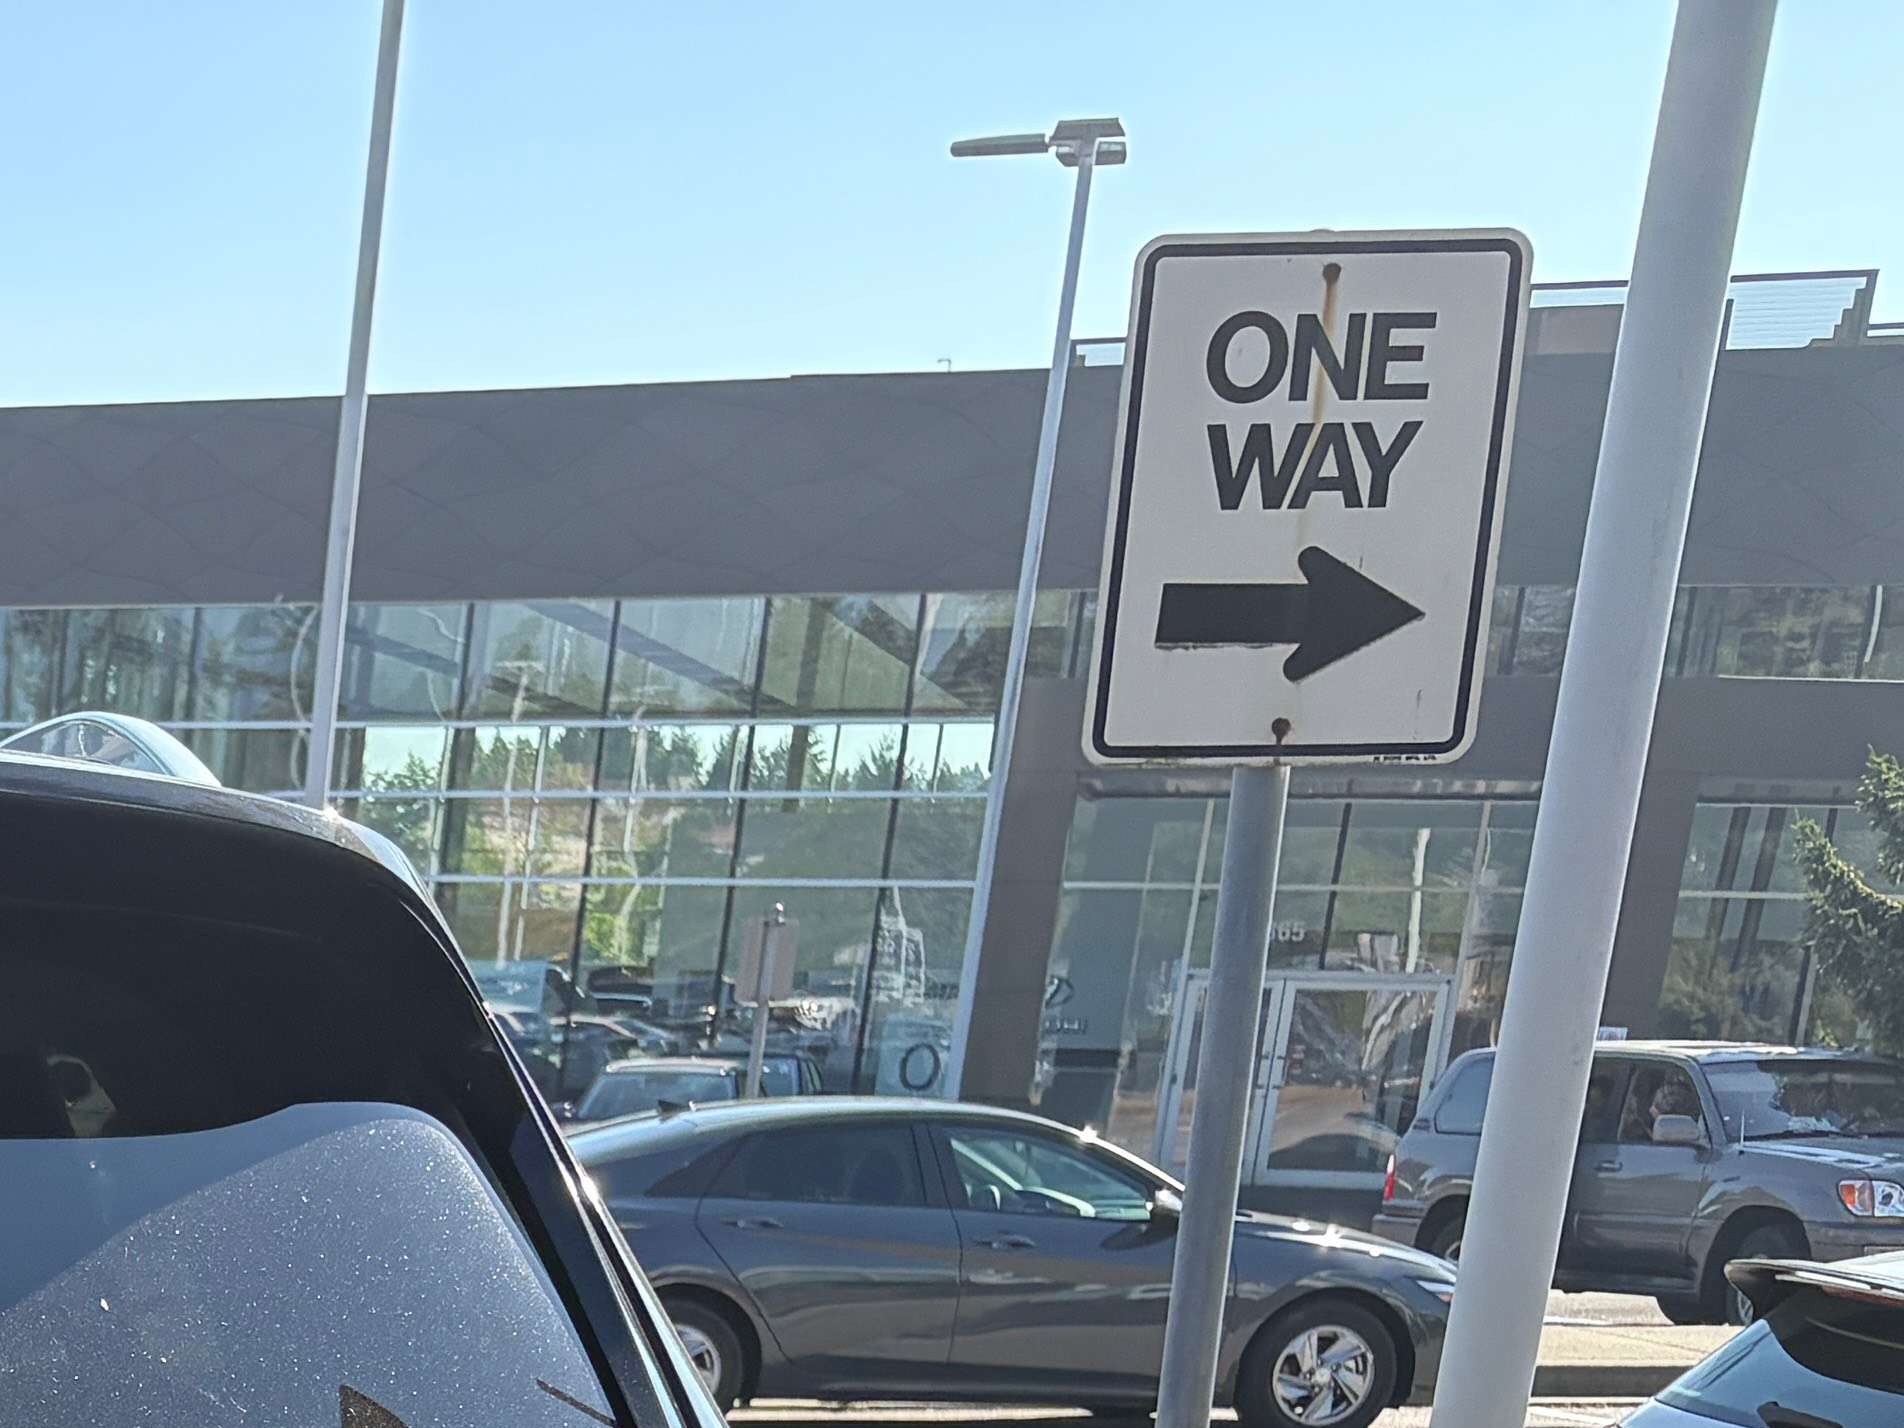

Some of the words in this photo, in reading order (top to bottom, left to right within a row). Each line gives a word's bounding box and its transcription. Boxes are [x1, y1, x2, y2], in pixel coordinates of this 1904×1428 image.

[1206, 310, 1437, 404] ONE
[1206, 420, 1424, 511] WAY
[1271, 919, 1305, 942] 65
